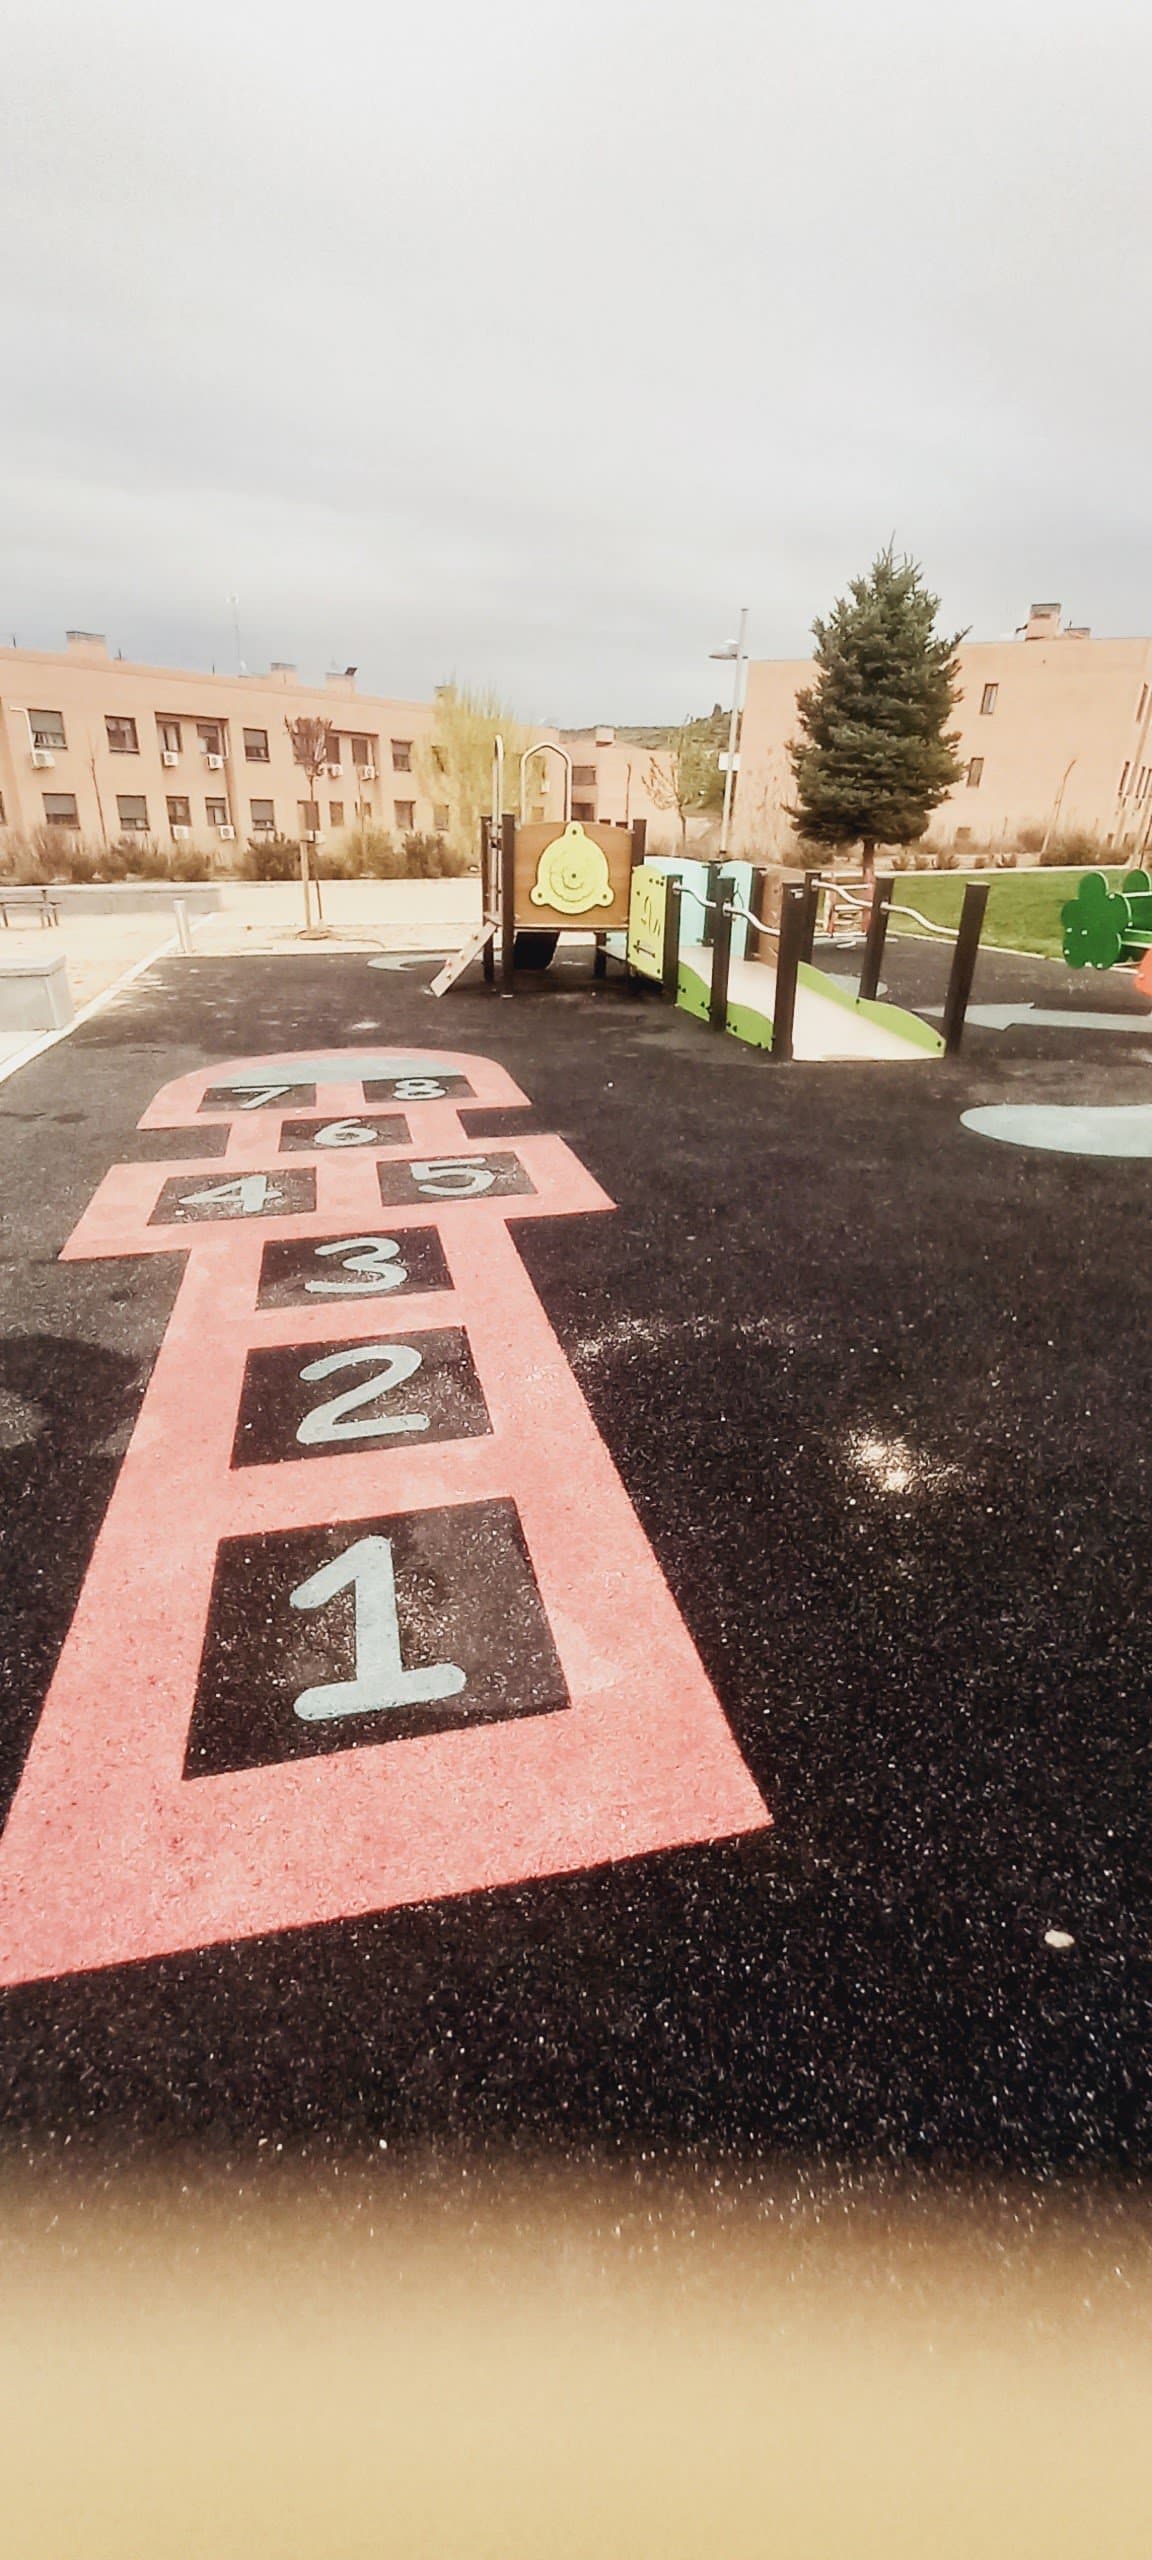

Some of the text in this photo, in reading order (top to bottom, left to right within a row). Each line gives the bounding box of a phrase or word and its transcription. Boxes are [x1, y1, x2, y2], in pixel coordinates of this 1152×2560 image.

[232, 1086, 291, 1110] 7
[392, 1078, 447, 1101] 8
[314, 1118, 379, 1147] 6
[178, 1174, 282, 1212] 4
[410, 1157, 497, 1196] 5
[304, 1236, 409, 1294] 3
[296, 1344, 430, 1444] 2
[289, 1534, 467, 1721] 1
